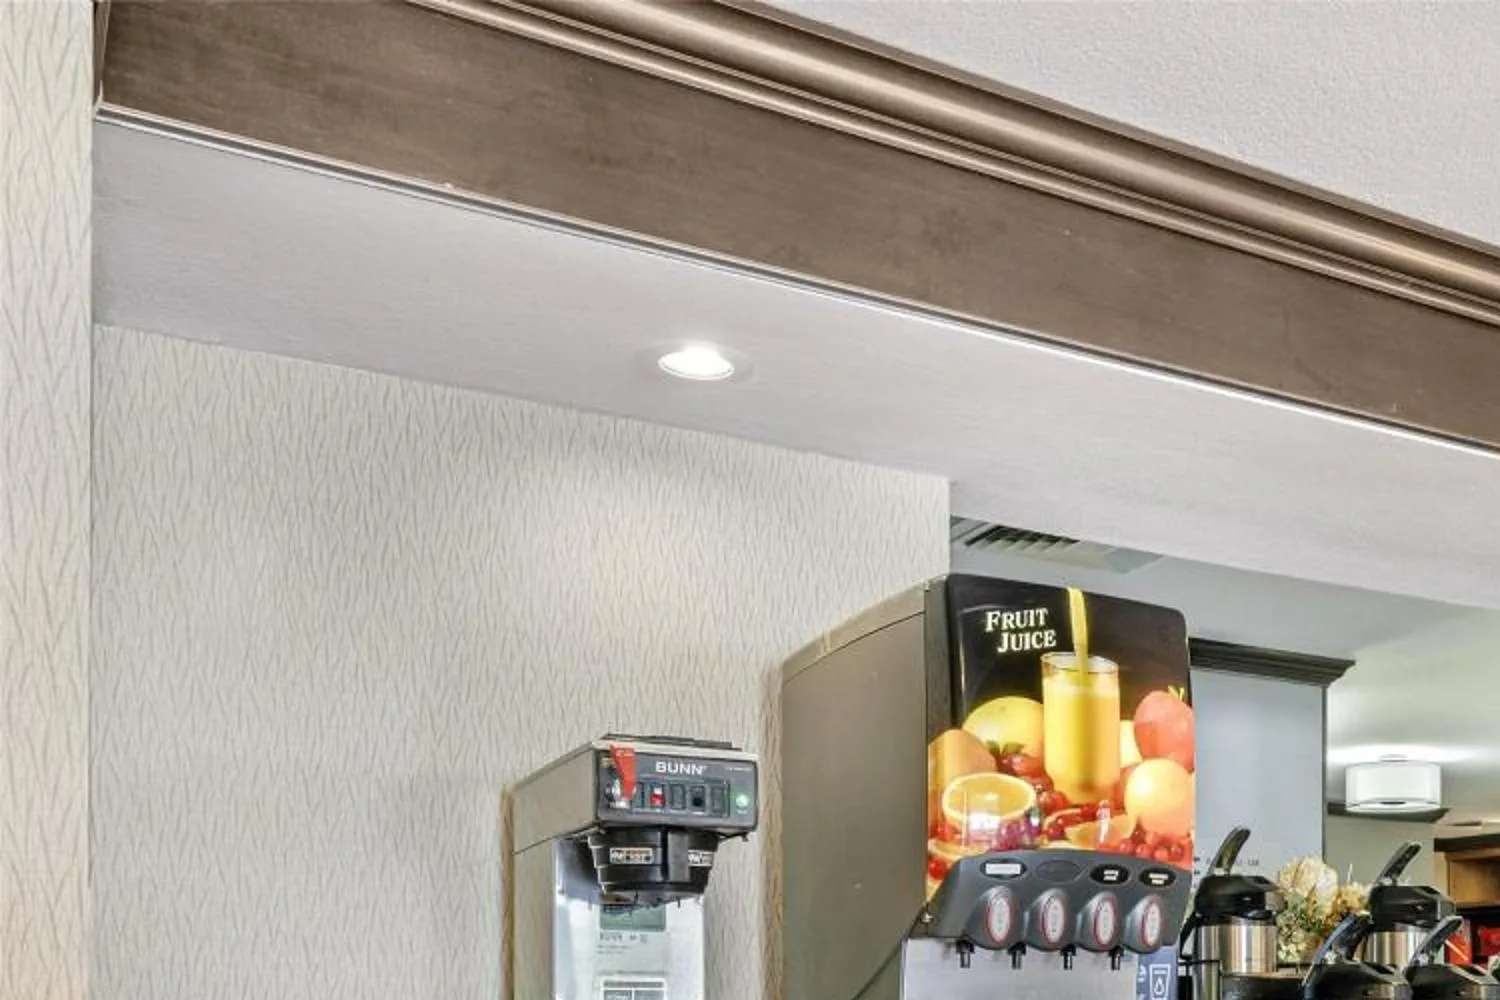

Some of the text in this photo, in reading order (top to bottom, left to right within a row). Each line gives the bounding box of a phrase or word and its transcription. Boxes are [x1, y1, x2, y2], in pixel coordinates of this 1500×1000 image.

[985, 608, 1048, 632] FRUIT
[997, 629, 1056, 653] JUICE
[655, 761, 704, 775] BUNN
